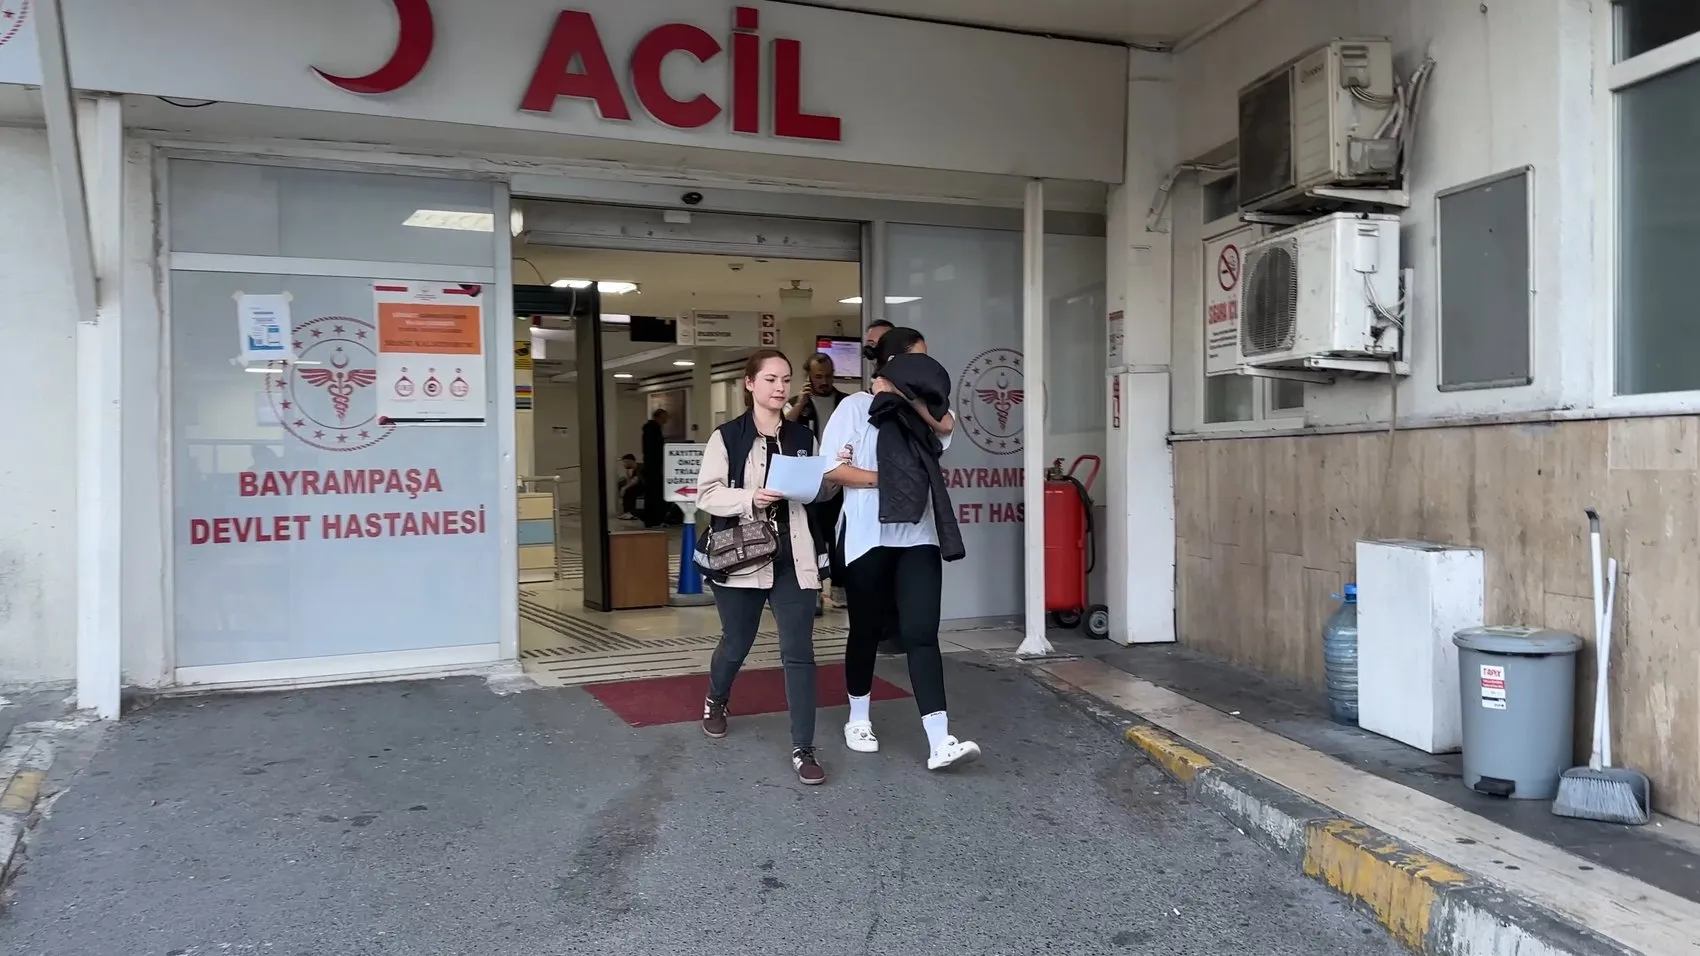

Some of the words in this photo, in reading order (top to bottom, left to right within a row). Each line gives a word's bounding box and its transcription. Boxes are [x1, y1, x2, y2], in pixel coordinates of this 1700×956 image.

[518, 6, 841, 141] ACİL
[239, 468, 443, 499] BAYRAMPAŞA
[190, 515, 311, 545] DEVLET
[322, 504, 486, 539] HASTANESİ
